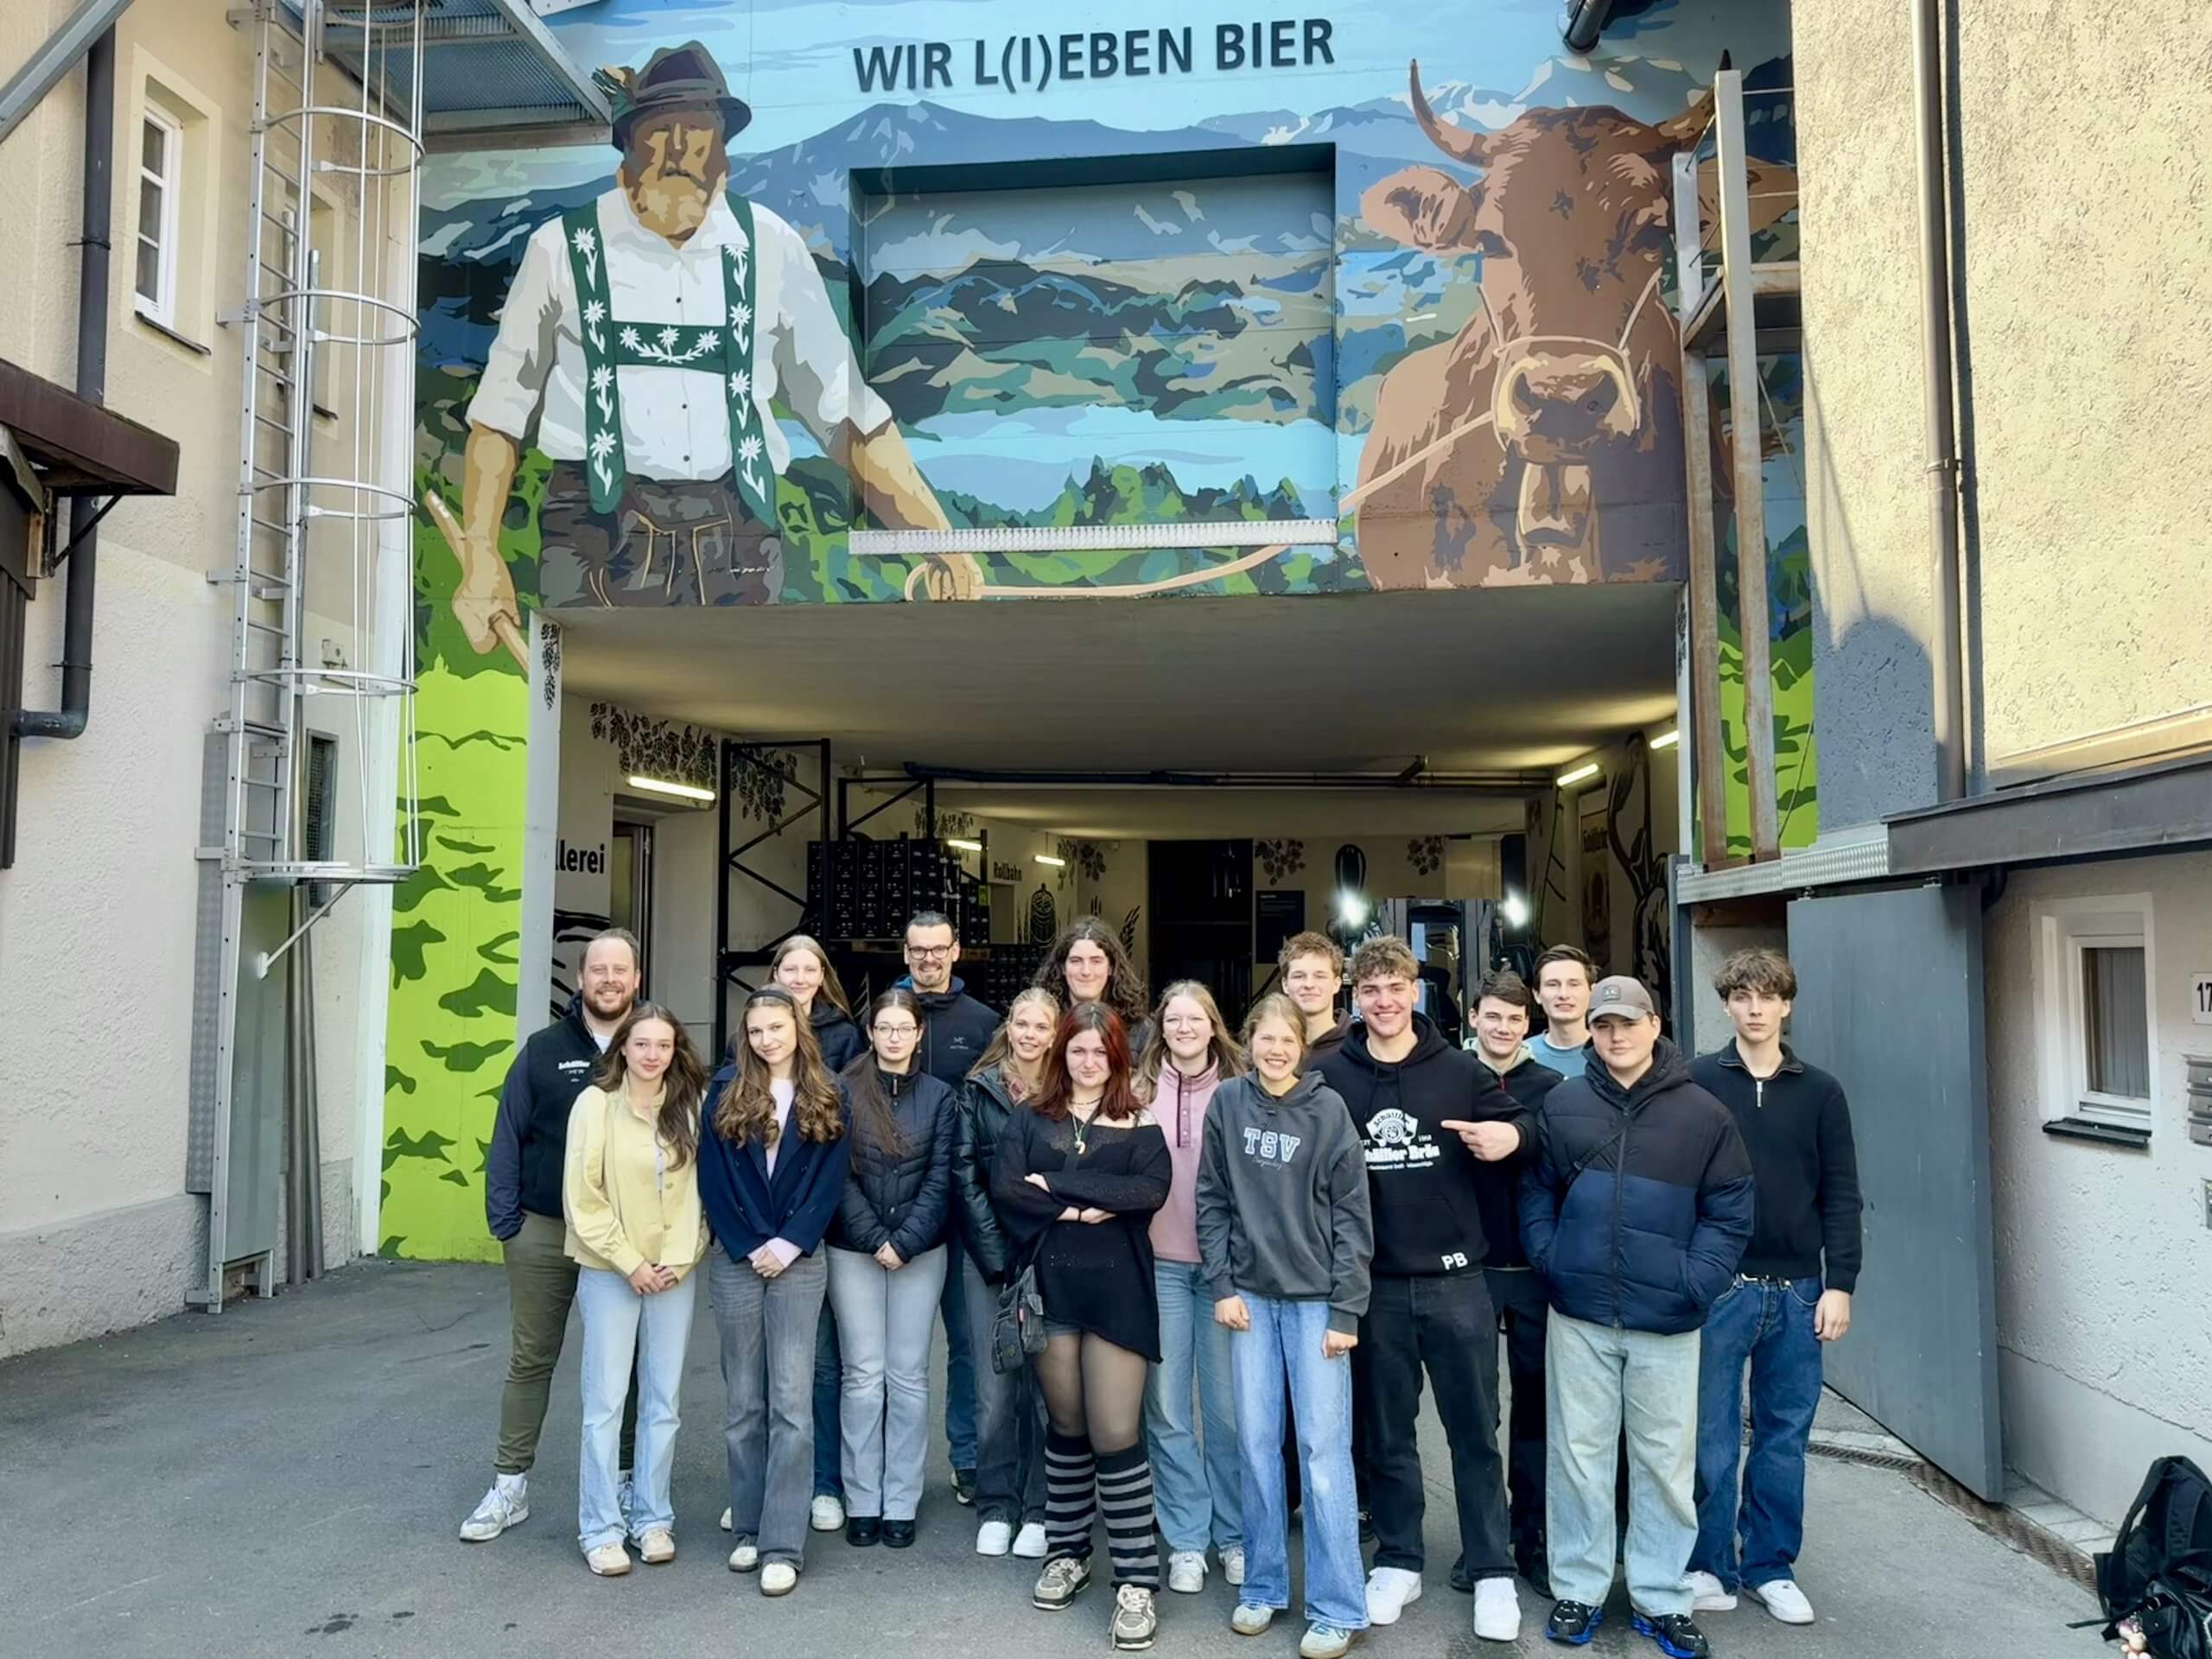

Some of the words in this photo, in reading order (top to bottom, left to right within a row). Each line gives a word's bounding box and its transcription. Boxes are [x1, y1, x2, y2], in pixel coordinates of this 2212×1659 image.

[853, 42, 952, 92] WIR
[975, 27, 1192, 93] L(I)EBEN
[1216, 18, 1335, 71] BIER
[2196, 982, 2212, 1013] 17
[1243, 1127, 1300, 1162] TSV
[1441, 1252, 1468, 1270] PB
